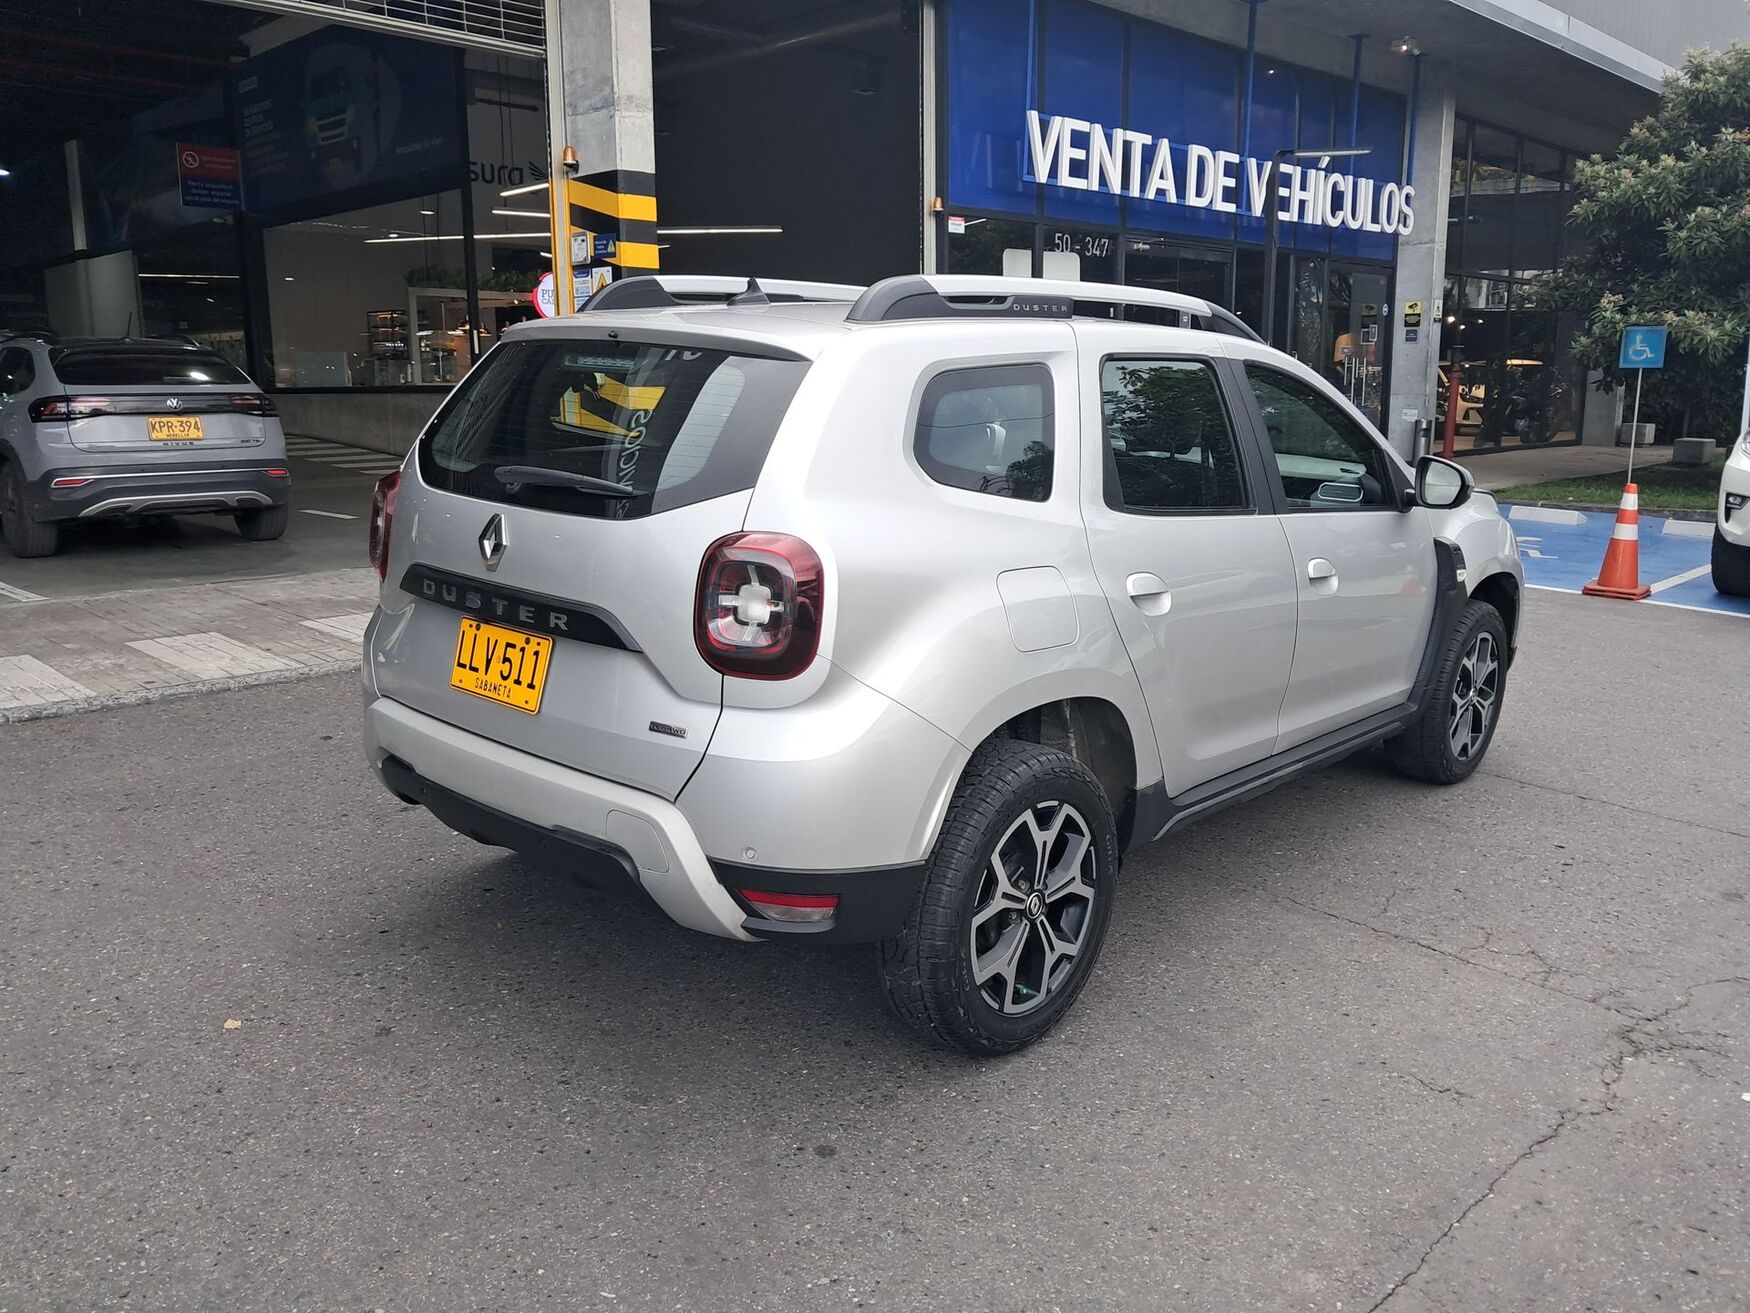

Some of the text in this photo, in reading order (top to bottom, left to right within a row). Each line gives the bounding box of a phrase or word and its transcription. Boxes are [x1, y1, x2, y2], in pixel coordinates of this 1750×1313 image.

[469, 161, 523, 185] sura
[1026, 110, 1415, 235] VENTA DE VEHÍCULOS
[1055, 233, 1070, 252] 50
[1085, 237, 1108, 257] 347
[541, 289, 555, 298] PU
[1013, 304, 1068, 312] DUSTER
[423, 579, 568, 630] DUSTER
[475, 677, 512, 699] SABANETA
